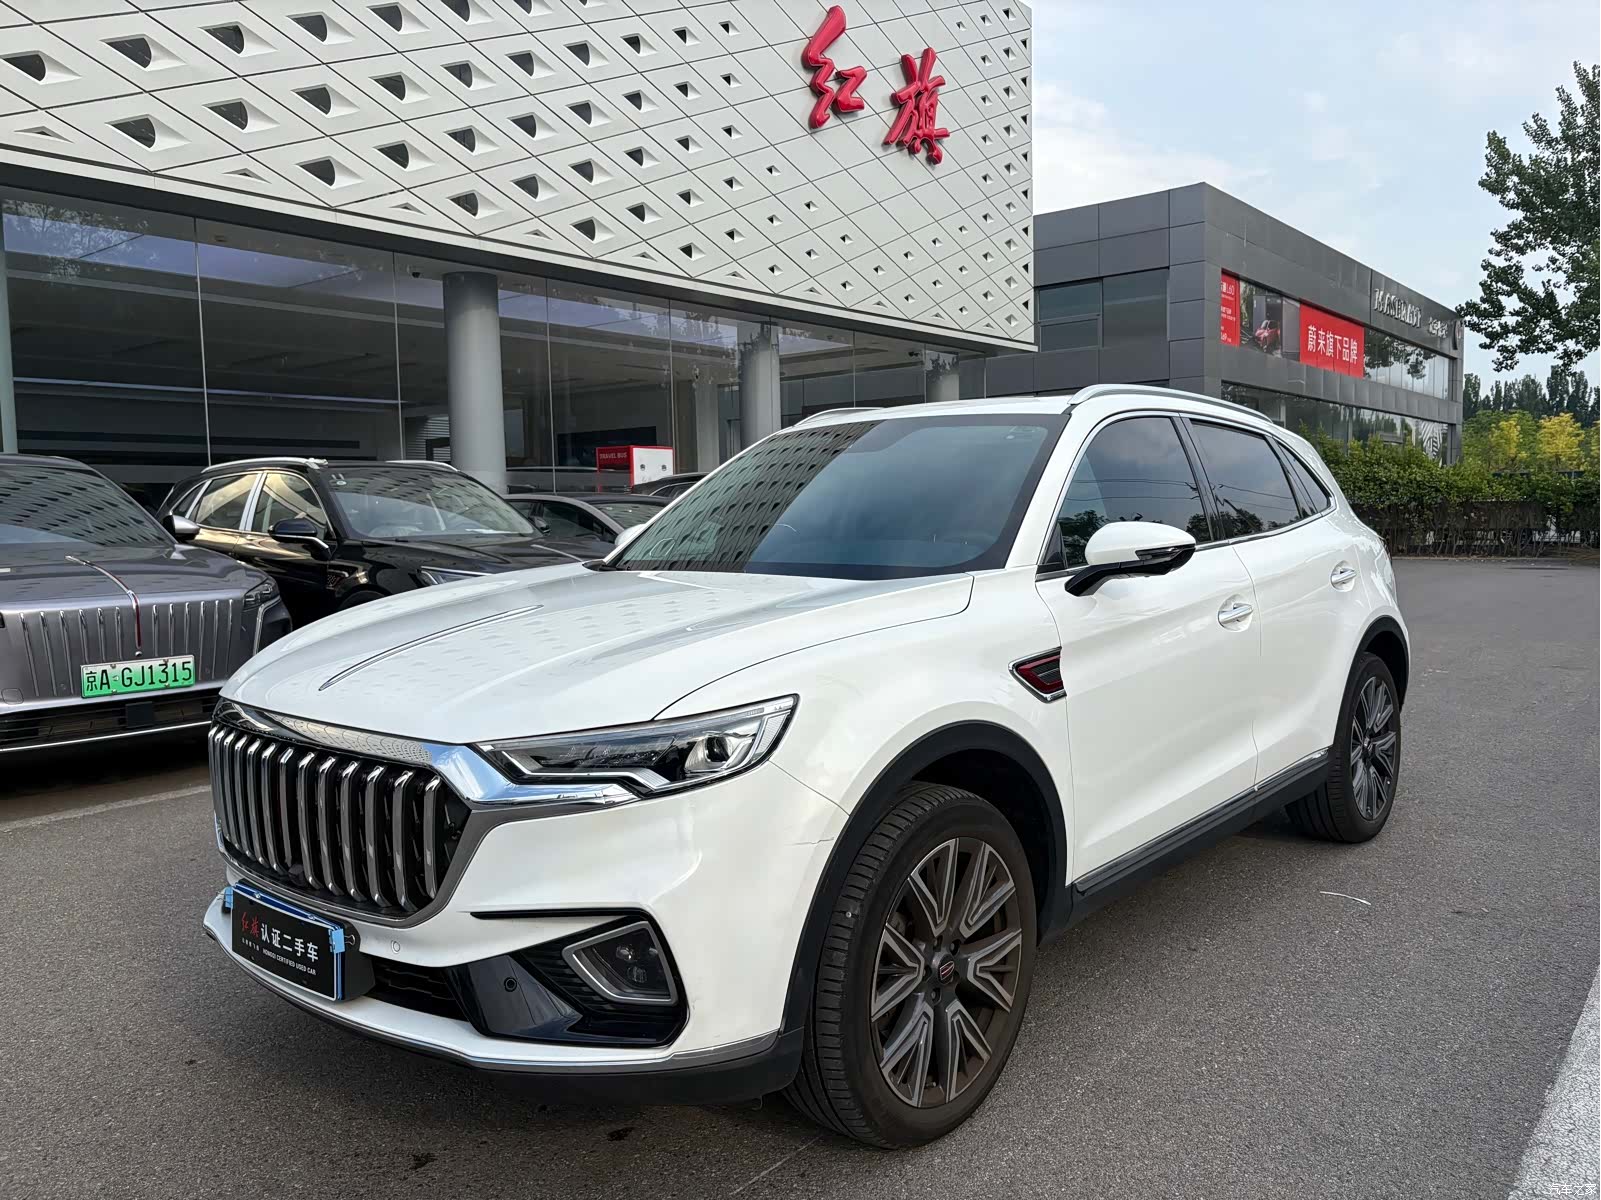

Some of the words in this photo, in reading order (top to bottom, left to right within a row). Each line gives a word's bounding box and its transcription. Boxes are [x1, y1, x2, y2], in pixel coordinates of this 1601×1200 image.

[801, 5, 950, 164] 红旗
[1307, 324, 1358, 365] 蔚来旗下品牌
[262, 948, 276, 959] HONGQI
[277, 955, 295, 968] CERTIFIED
[296, 962, 307, 972] USED
[307, 967, 316, 975] CAR
